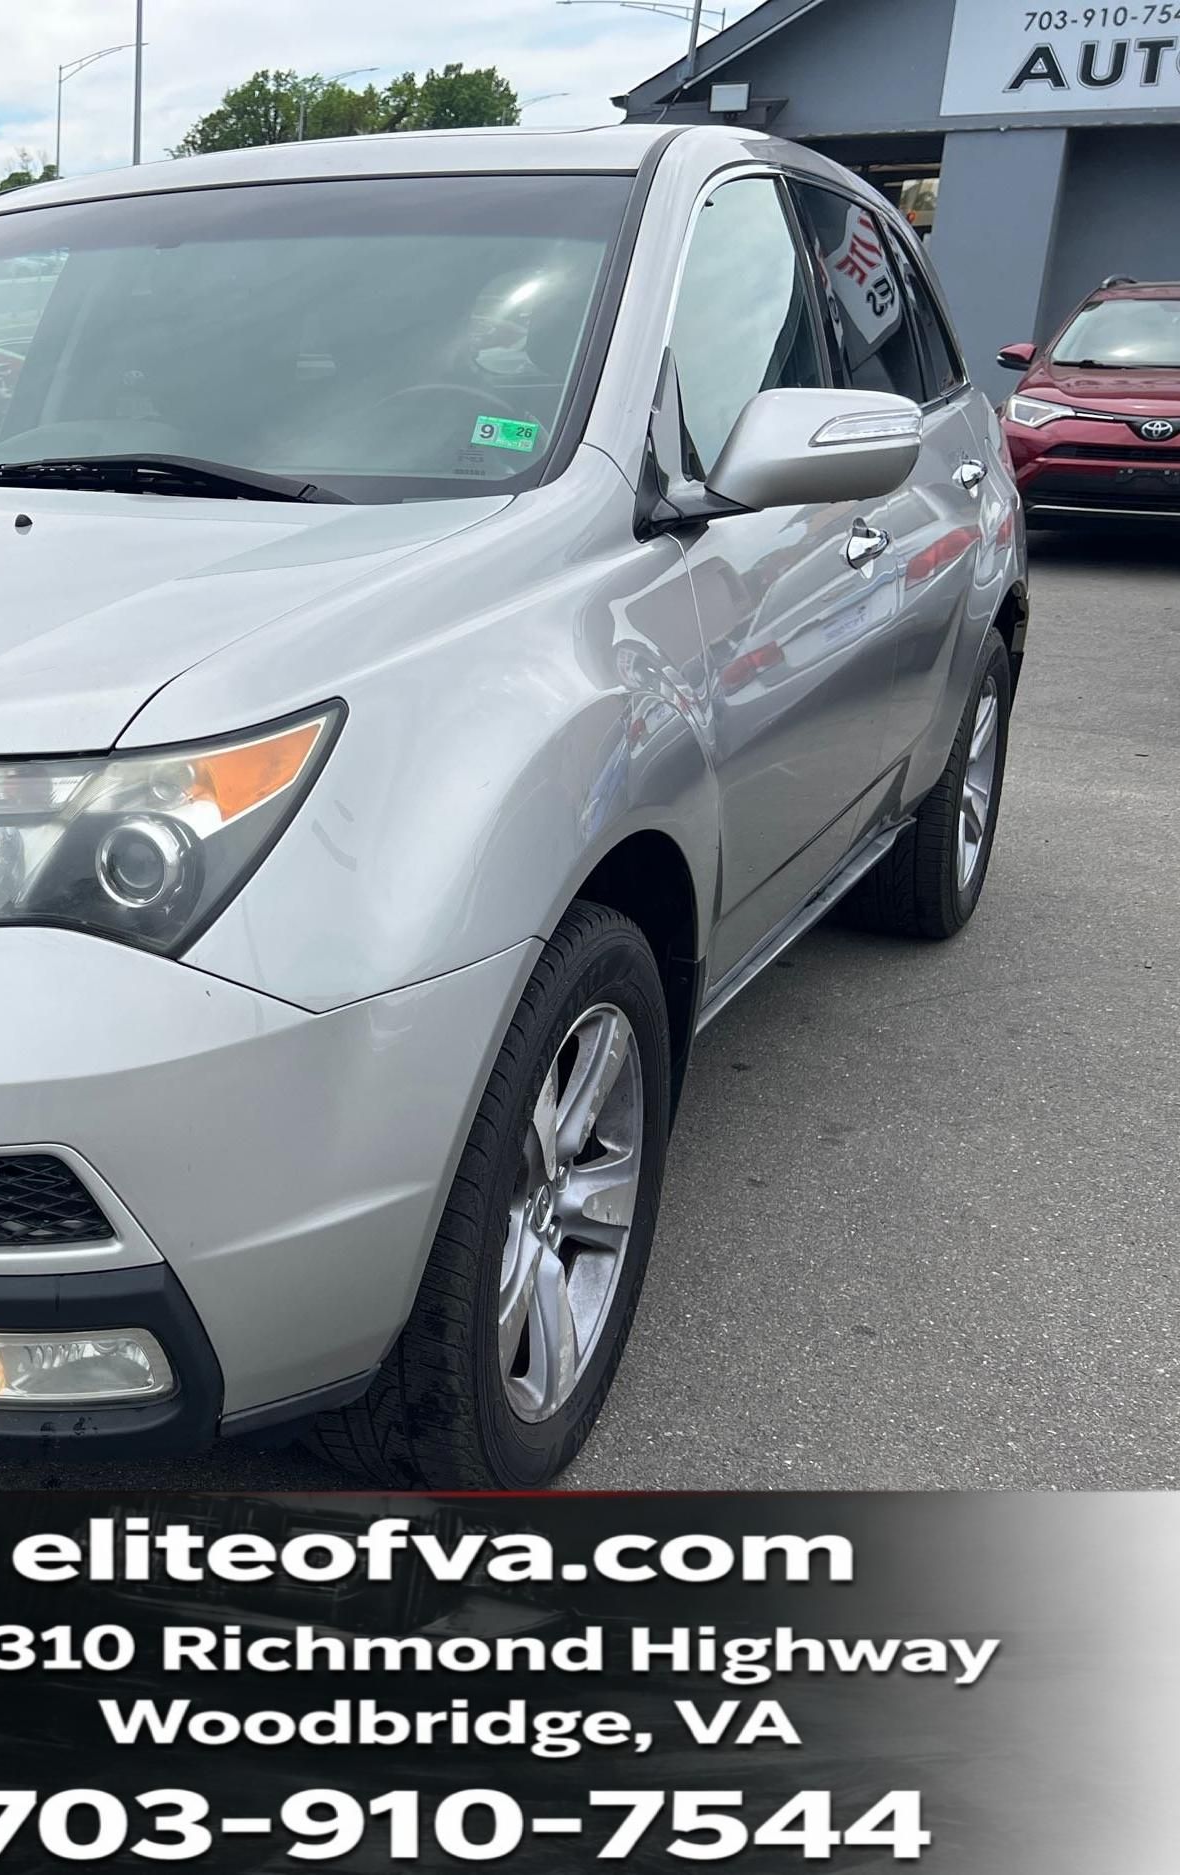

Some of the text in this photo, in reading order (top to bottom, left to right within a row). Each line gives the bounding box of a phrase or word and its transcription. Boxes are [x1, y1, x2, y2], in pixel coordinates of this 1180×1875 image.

[1002, 36, 1180, 93] AUT
[479, 424, 533, 439] 9 26
